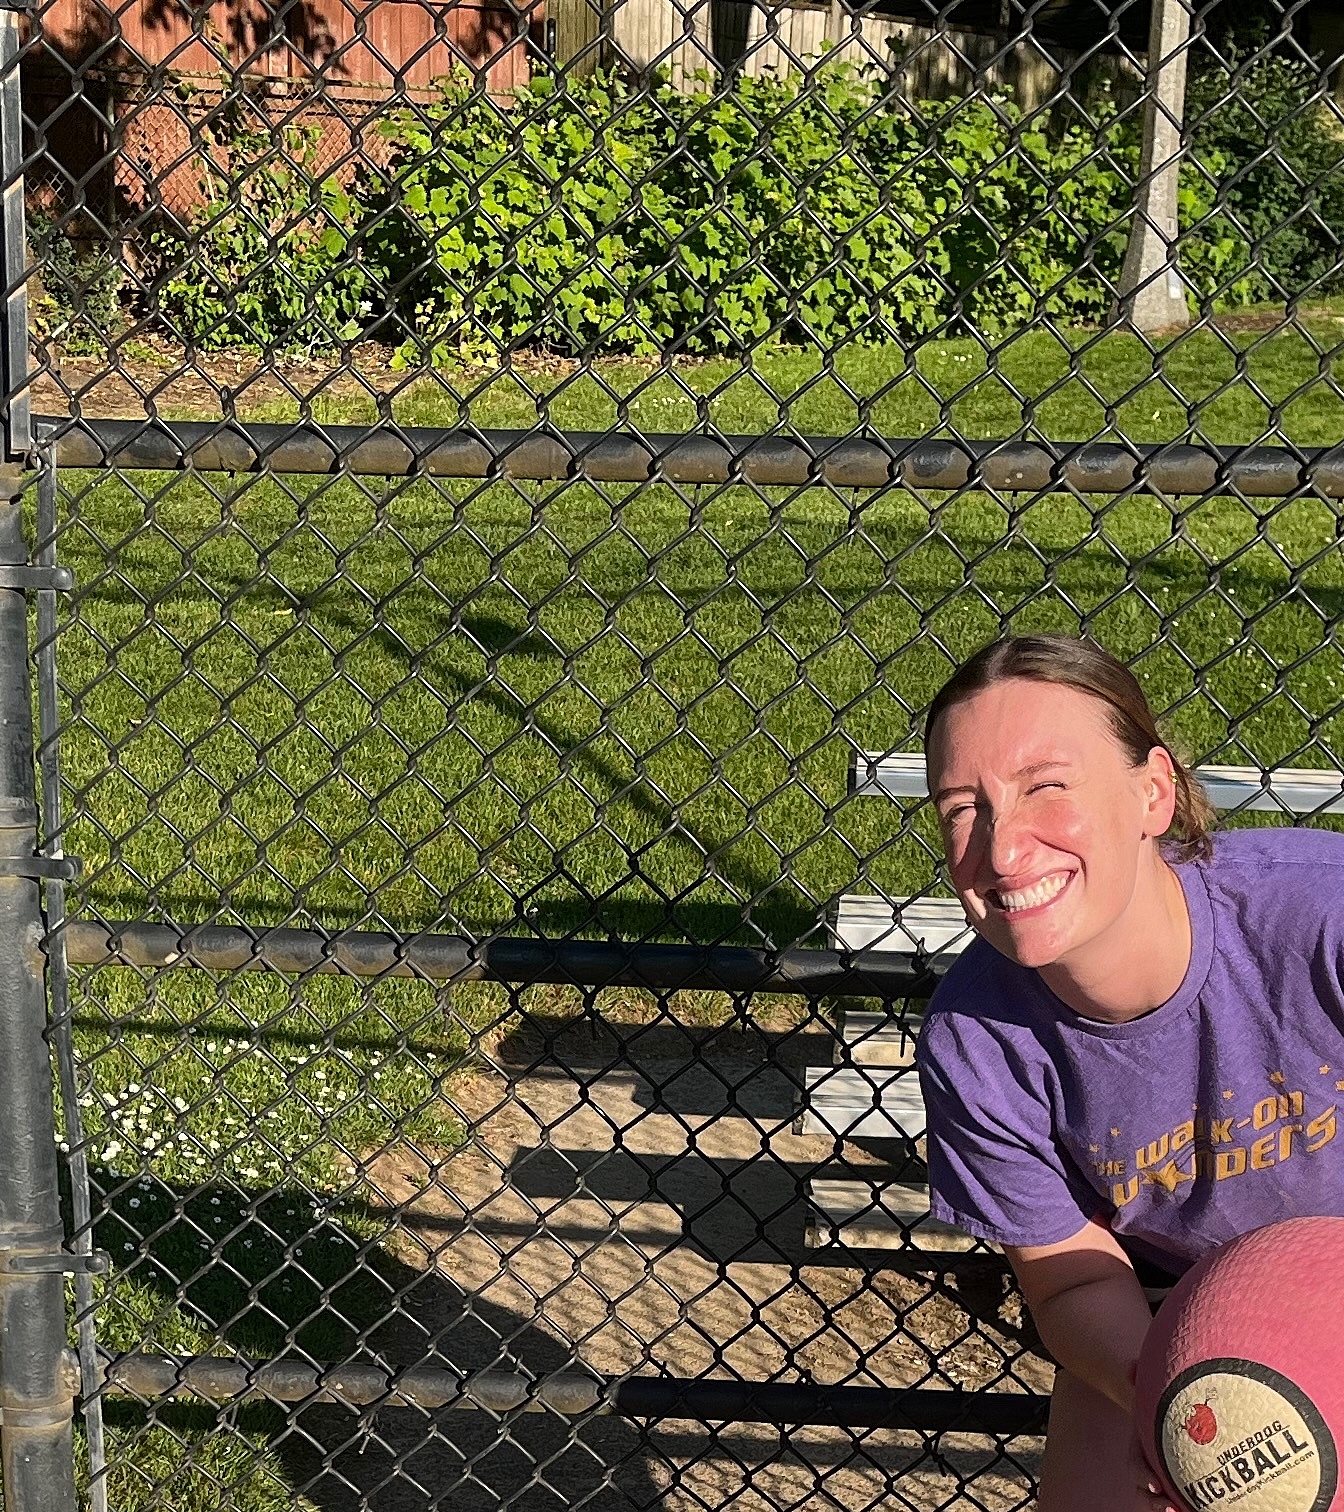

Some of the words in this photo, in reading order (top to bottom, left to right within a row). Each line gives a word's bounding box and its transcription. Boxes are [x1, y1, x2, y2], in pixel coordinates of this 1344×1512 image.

[1093, 1157, 1126, 1177] THE
[1216, 1420, 1282, 1466] UNDERDOG
[1183, 1429, 1309, 1509] KICKBALL
